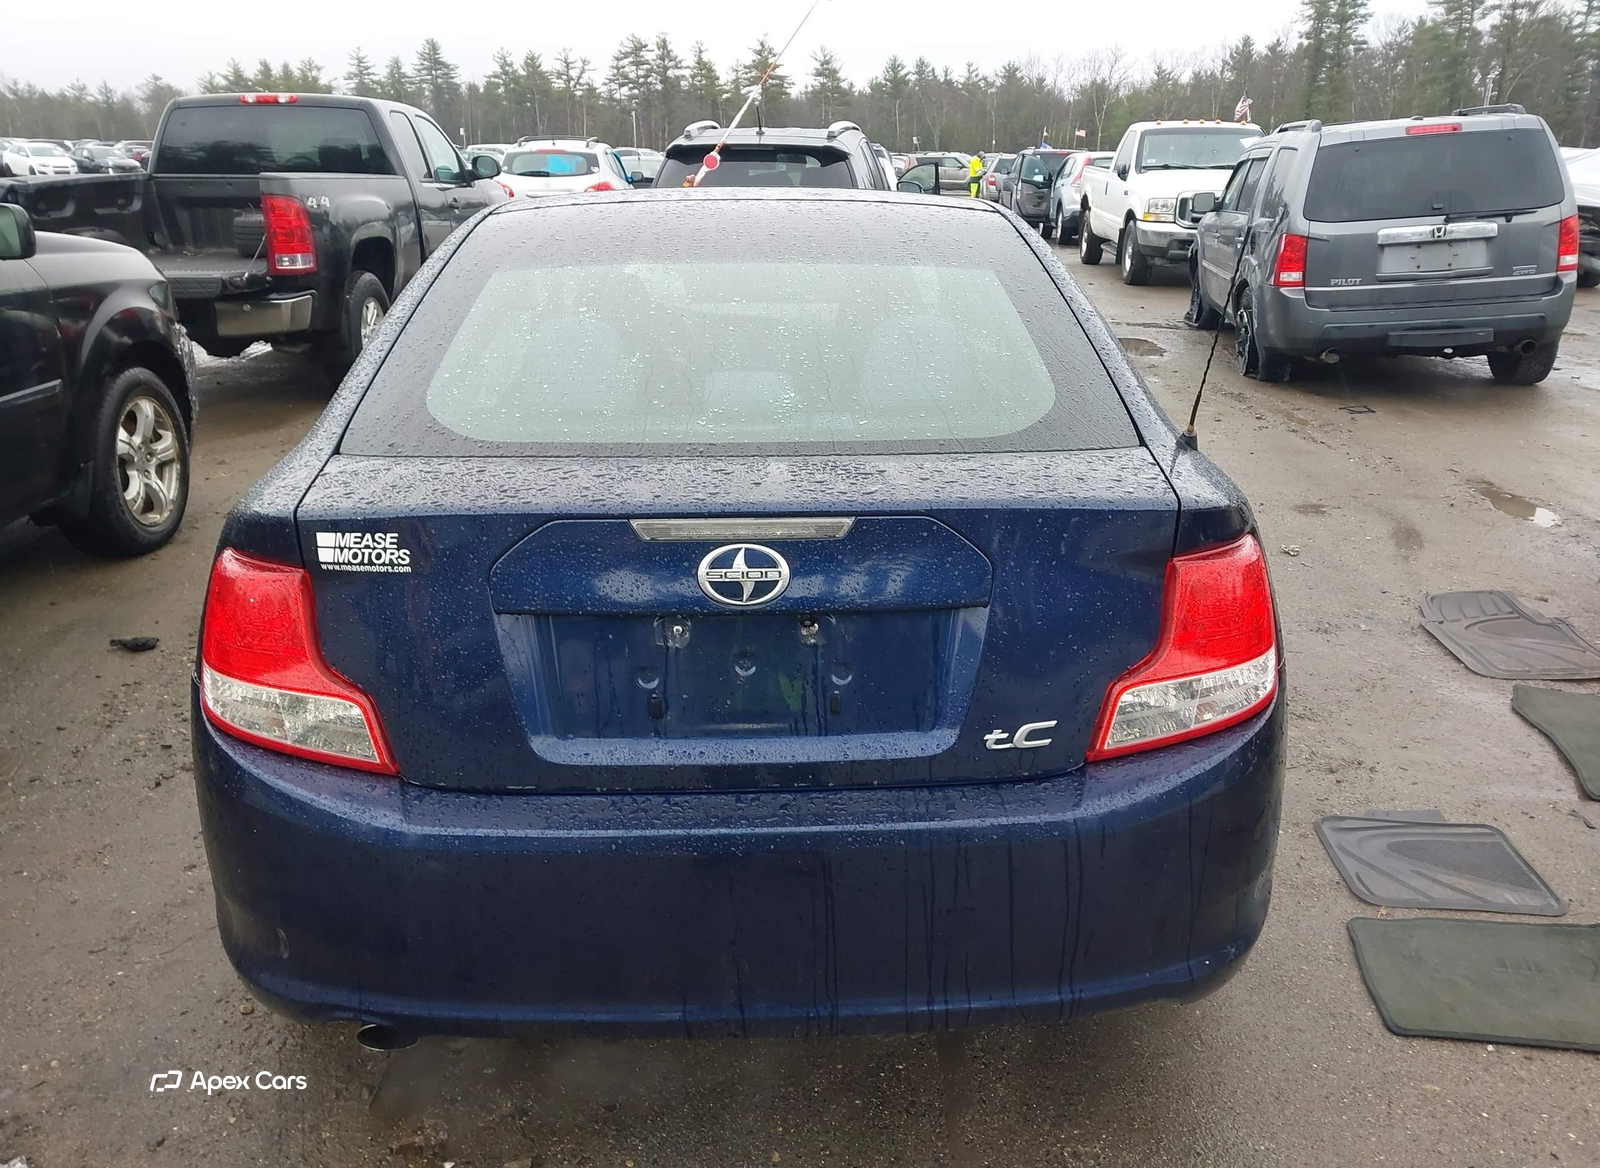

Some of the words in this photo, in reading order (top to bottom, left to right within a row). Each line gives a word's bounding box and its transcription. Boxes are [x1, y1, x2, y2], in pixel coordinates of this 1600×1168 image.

[307, 196, 330, 208] 44
[1330, 277, 1362, 286] PILOT
[335, 532, 399, 549] MEASE
[334, 548, 411, 565] MOTORS
[320, 563, 412, 573] www.measemotors.com
[705, 570, 782, 580] SCION
[983, 720, 1058, 750] tC
